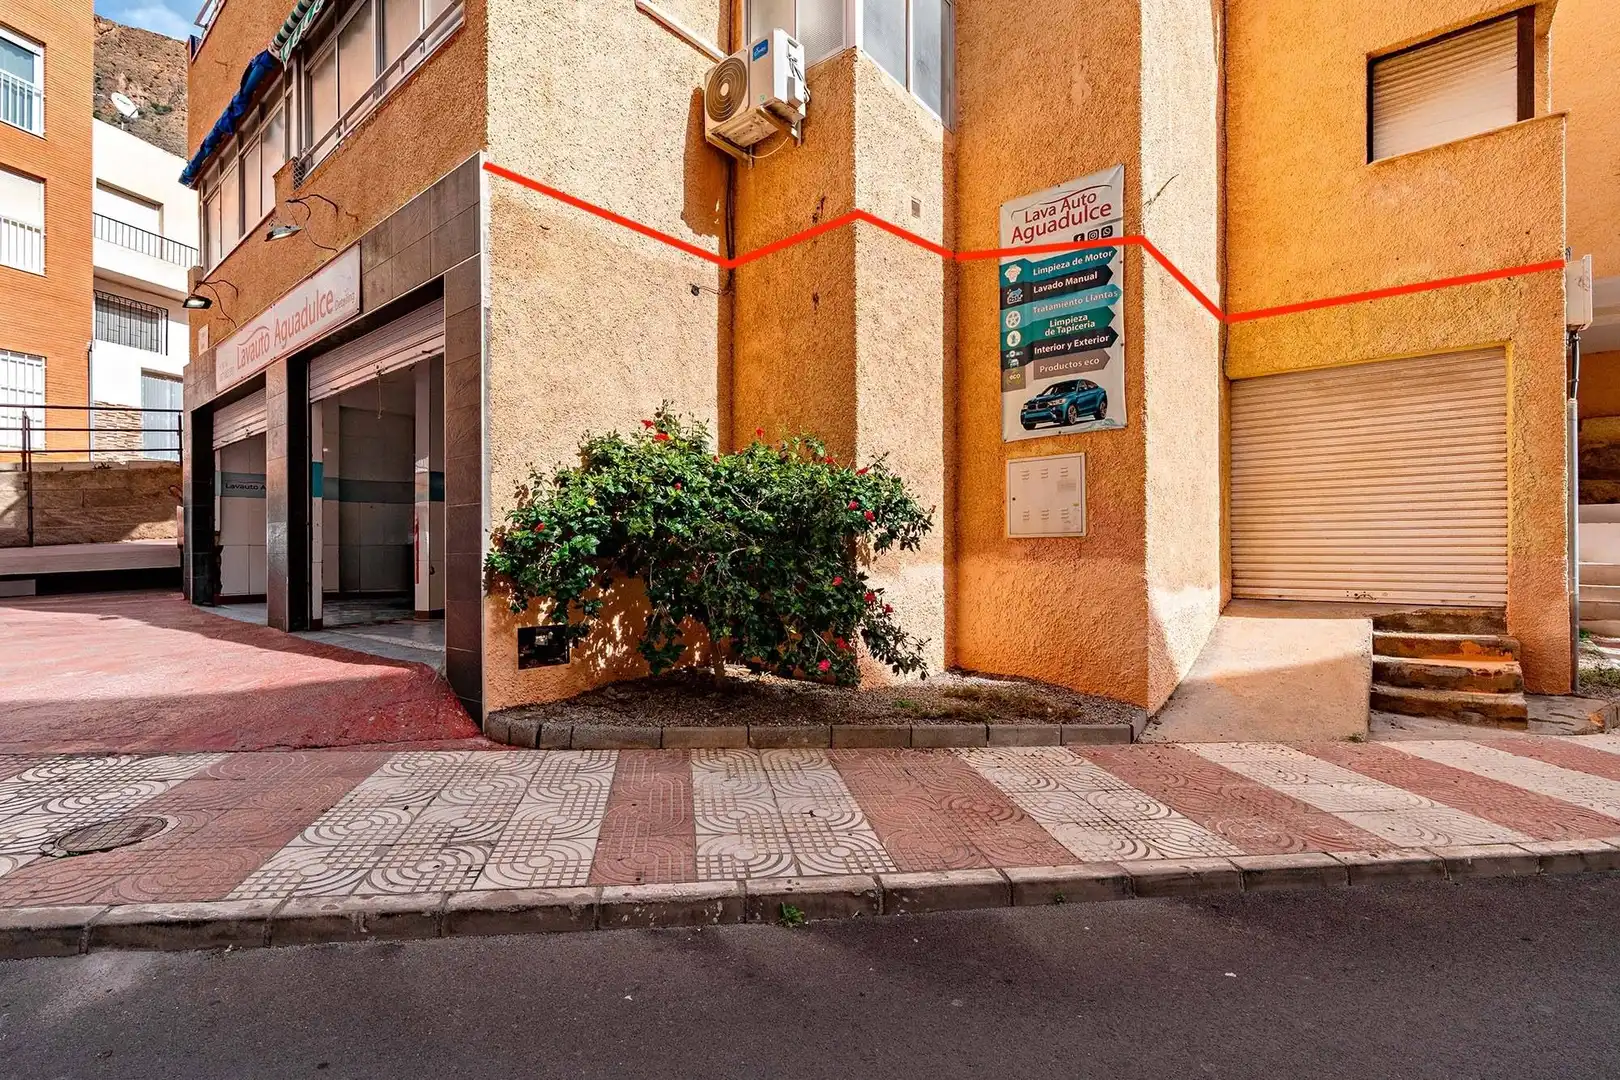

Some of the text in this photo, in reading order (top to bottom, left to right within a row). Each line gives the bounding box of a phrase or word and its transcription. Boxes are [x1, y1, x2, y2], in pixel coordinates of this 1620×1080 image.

[1025, 192, 1097, 224] Lava Auto
[1011, 203, 1112, 244] Aguadulce
[1033, 250, 1113, 276] Limpieza de Motor
[1033, 271, 1098, 294] Lavado Manual
[1033, 290, 1118, 313] Tratamiento Llantas
[236, 331, 270, 370] Lavauto
[273, 289, 334, 349] Aguadulce
[1044, 328, 1056, 337] de
[1049, 314, 1088, 328] Limpieza
[1034, 334, 1110, 355] Interior y Exterior
[1009, 373, 1021, 381] eco
[1039, 358, 1100, 373] Productos eco
